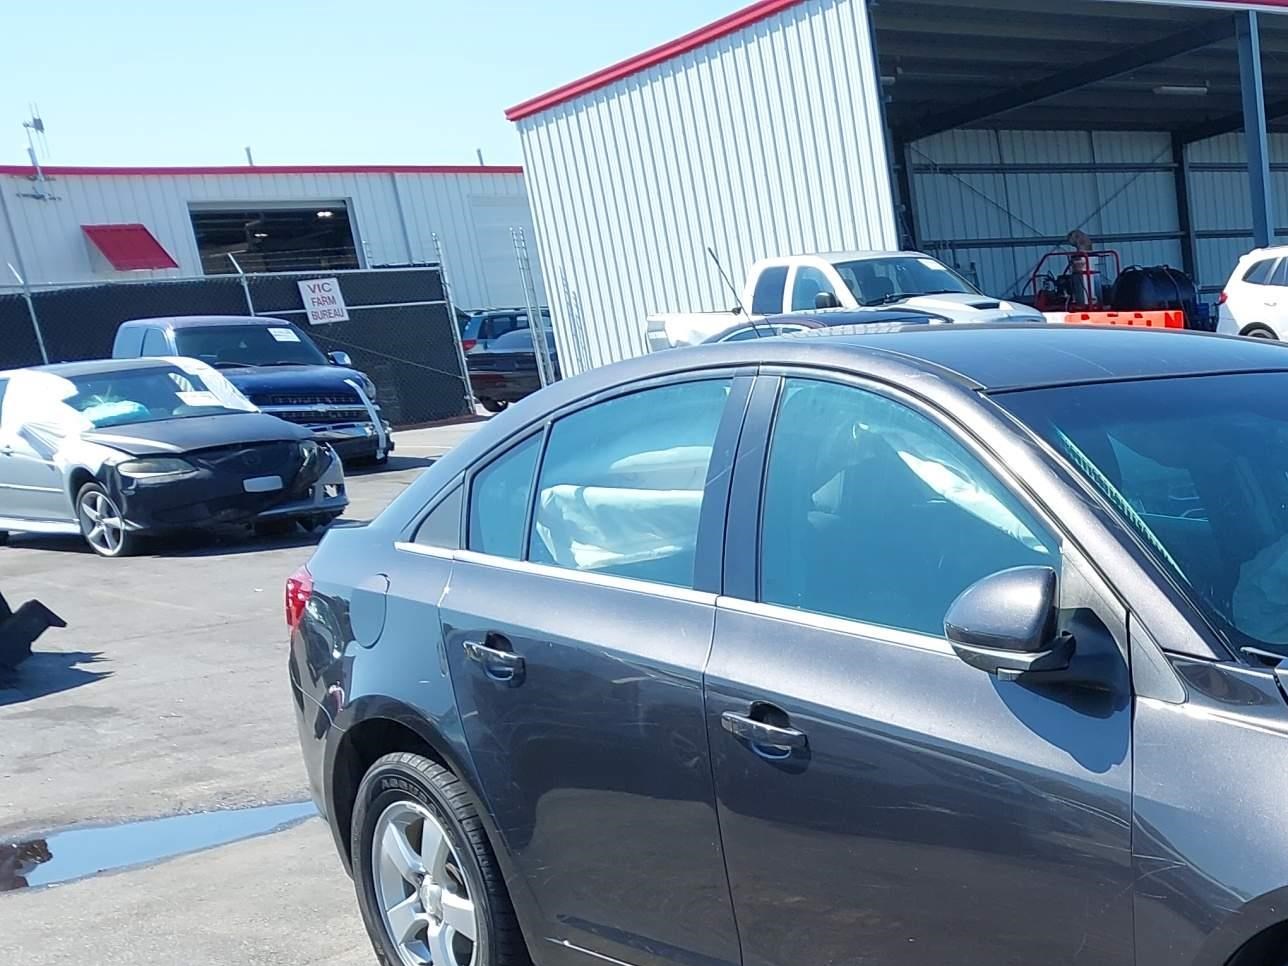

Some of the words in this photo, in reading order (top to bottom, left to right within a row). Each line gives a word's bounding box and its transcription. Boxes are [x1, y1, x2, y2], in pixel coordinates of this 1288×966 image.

[306, 282, 333, 294] VIC
[310, 295, 337, 307] FARM
[311, 307, 345, 321] BUREAU
